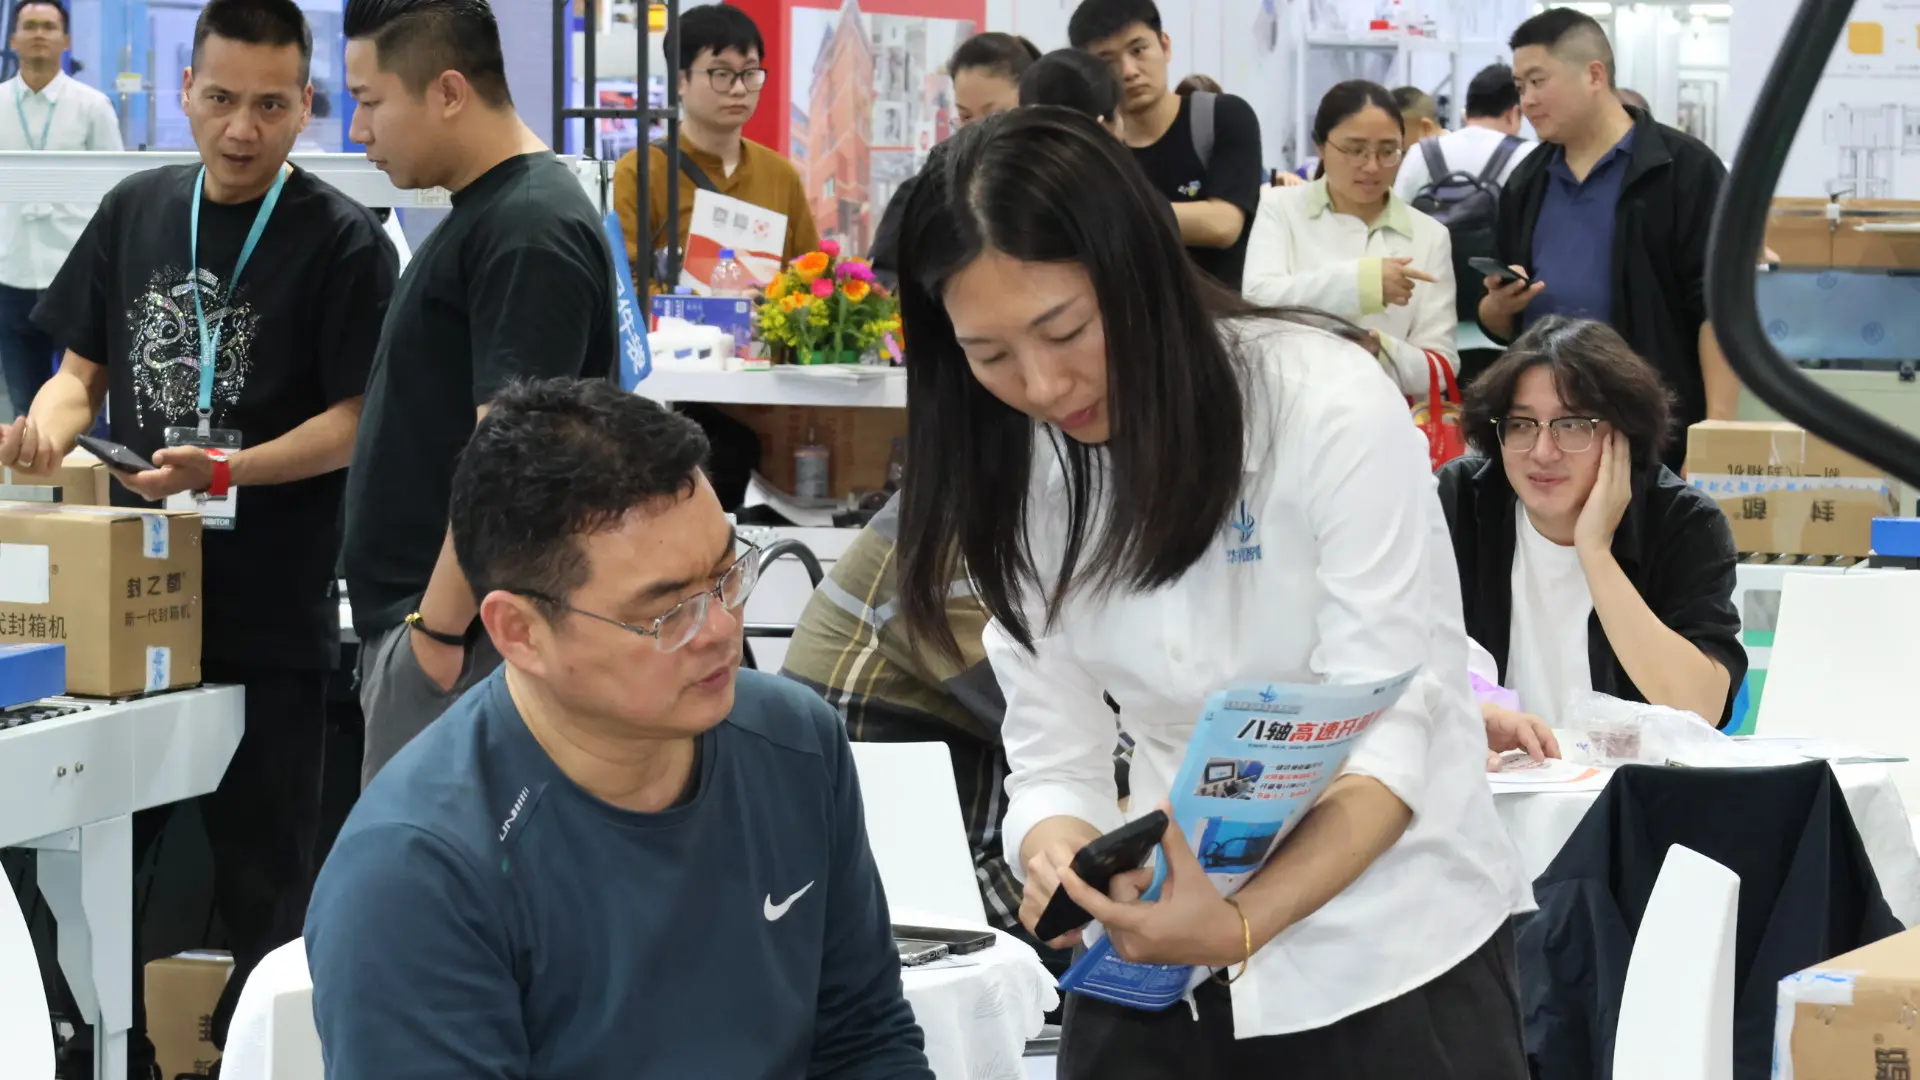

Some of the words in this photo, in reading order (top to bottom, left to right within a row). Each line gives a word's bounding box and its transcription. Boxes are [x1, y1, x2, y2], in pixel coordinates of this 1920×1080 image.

[124, 604, 191, 628] 新一代封箱机
